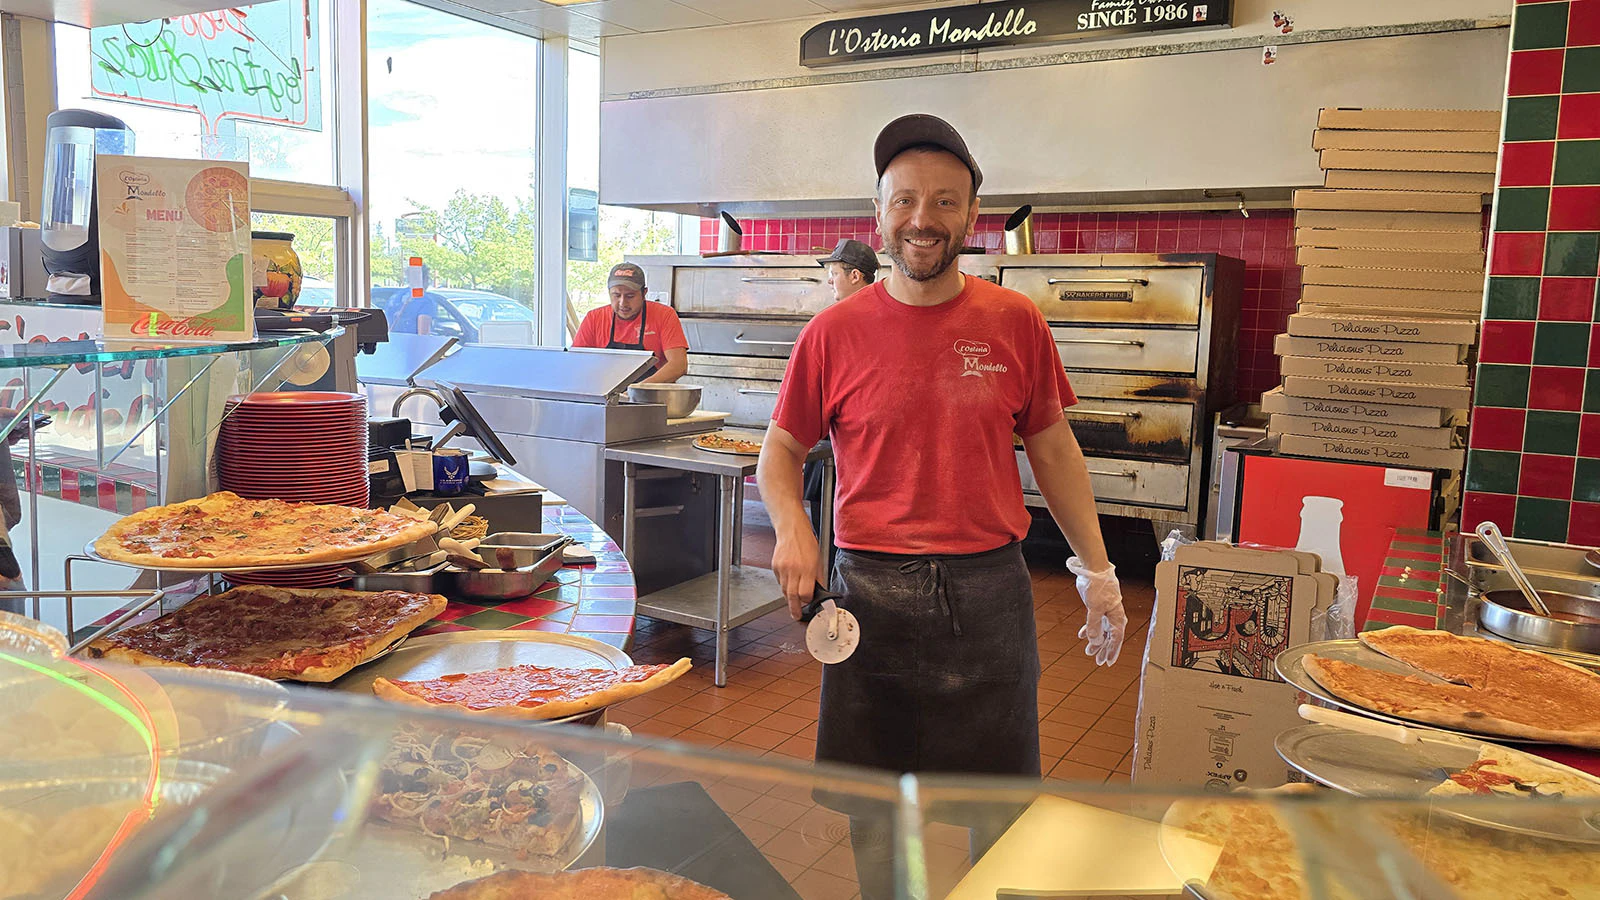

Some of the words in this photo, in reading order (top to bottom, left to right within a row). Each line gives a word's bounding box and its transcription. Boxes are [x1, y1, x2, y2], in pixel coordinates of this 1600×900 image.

[1077, 8, 1137, 30] SINCE
[1142, 2, 1188, 23] 1986
[928, 8, 1037, 45] Mondello
[127, 185, 167, 198] Mondello
[146, 209, 184, 222] MENU
[1331, 322, 1380, 334] Delicious
[1380, 324, 1421, 336] Pizza
[1317, 342, 1364, 354] Delicious
[1365, 344, 1404, 356] Pizza
[963, 357, 1008, 373] Mondello
[1324, 363, 1373, 375] Delicious
[1373, 365, 1413, 377] Pizza
[1328, 384, 1376, 396] Delicious
[1376, 387, 1417, 399] Pizza
[1303, 402, 1350, 414] Delicious
[1350, 405, 1389, 417] Pizza
[1311, 422, 1359, 435] Delicious
[1359, 426, 1398, 438] Pizza
[1323, 443, 1371, 456] Delicious
[1371, 446, 1410, 459] Pizza
